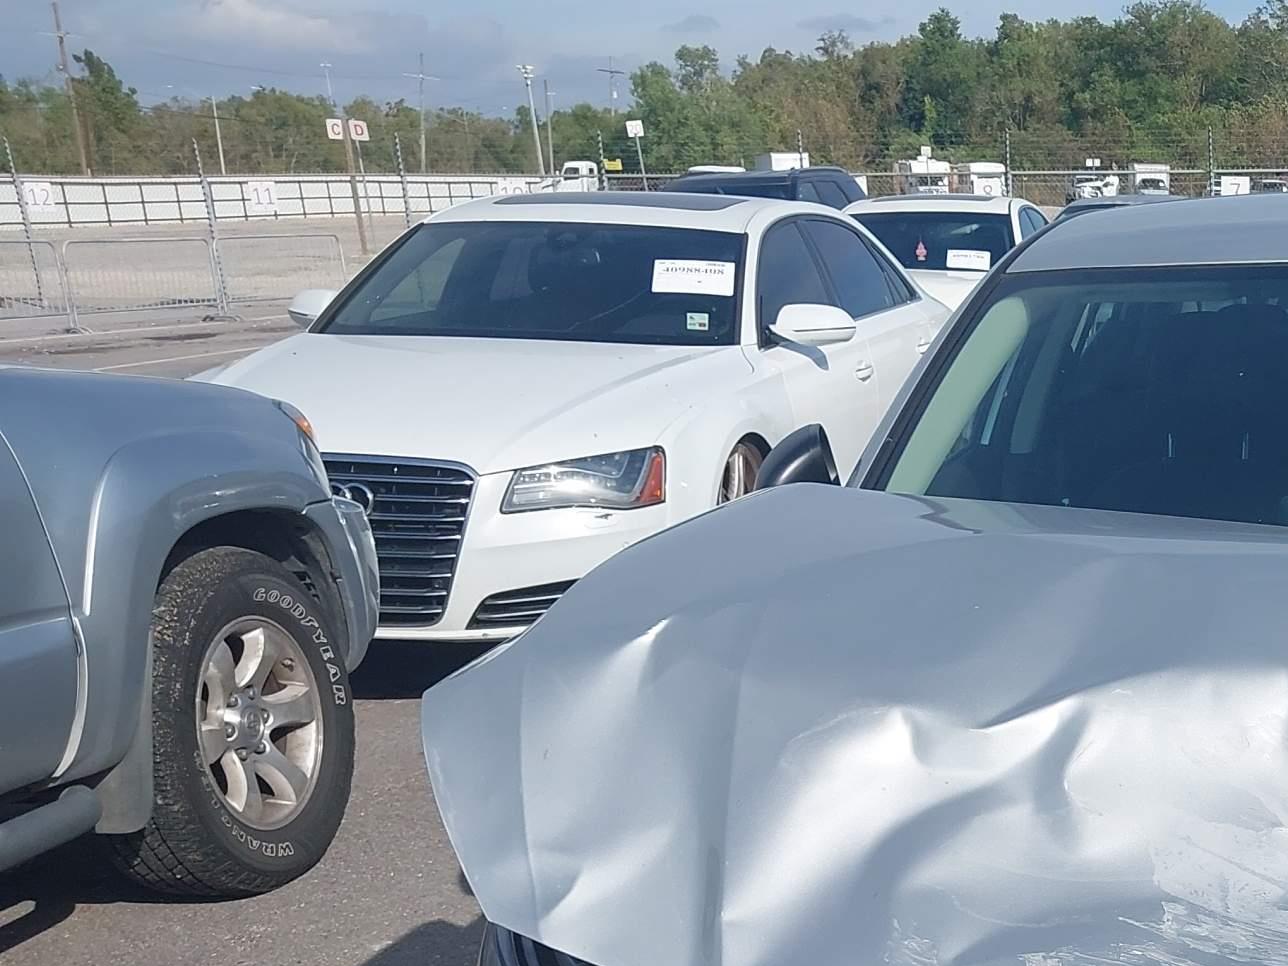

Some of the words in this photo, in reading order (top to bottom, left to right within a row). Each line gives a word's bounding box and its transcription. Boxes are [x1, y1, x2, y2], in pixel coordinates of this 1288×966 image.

[331, 122, 341, 136] C
[353, 123, 365, 137] D
[27, 187, 53, 206] 12
[253, 187, 276, 205] 11
[253, 587, 347, 706] GOODYEAR
